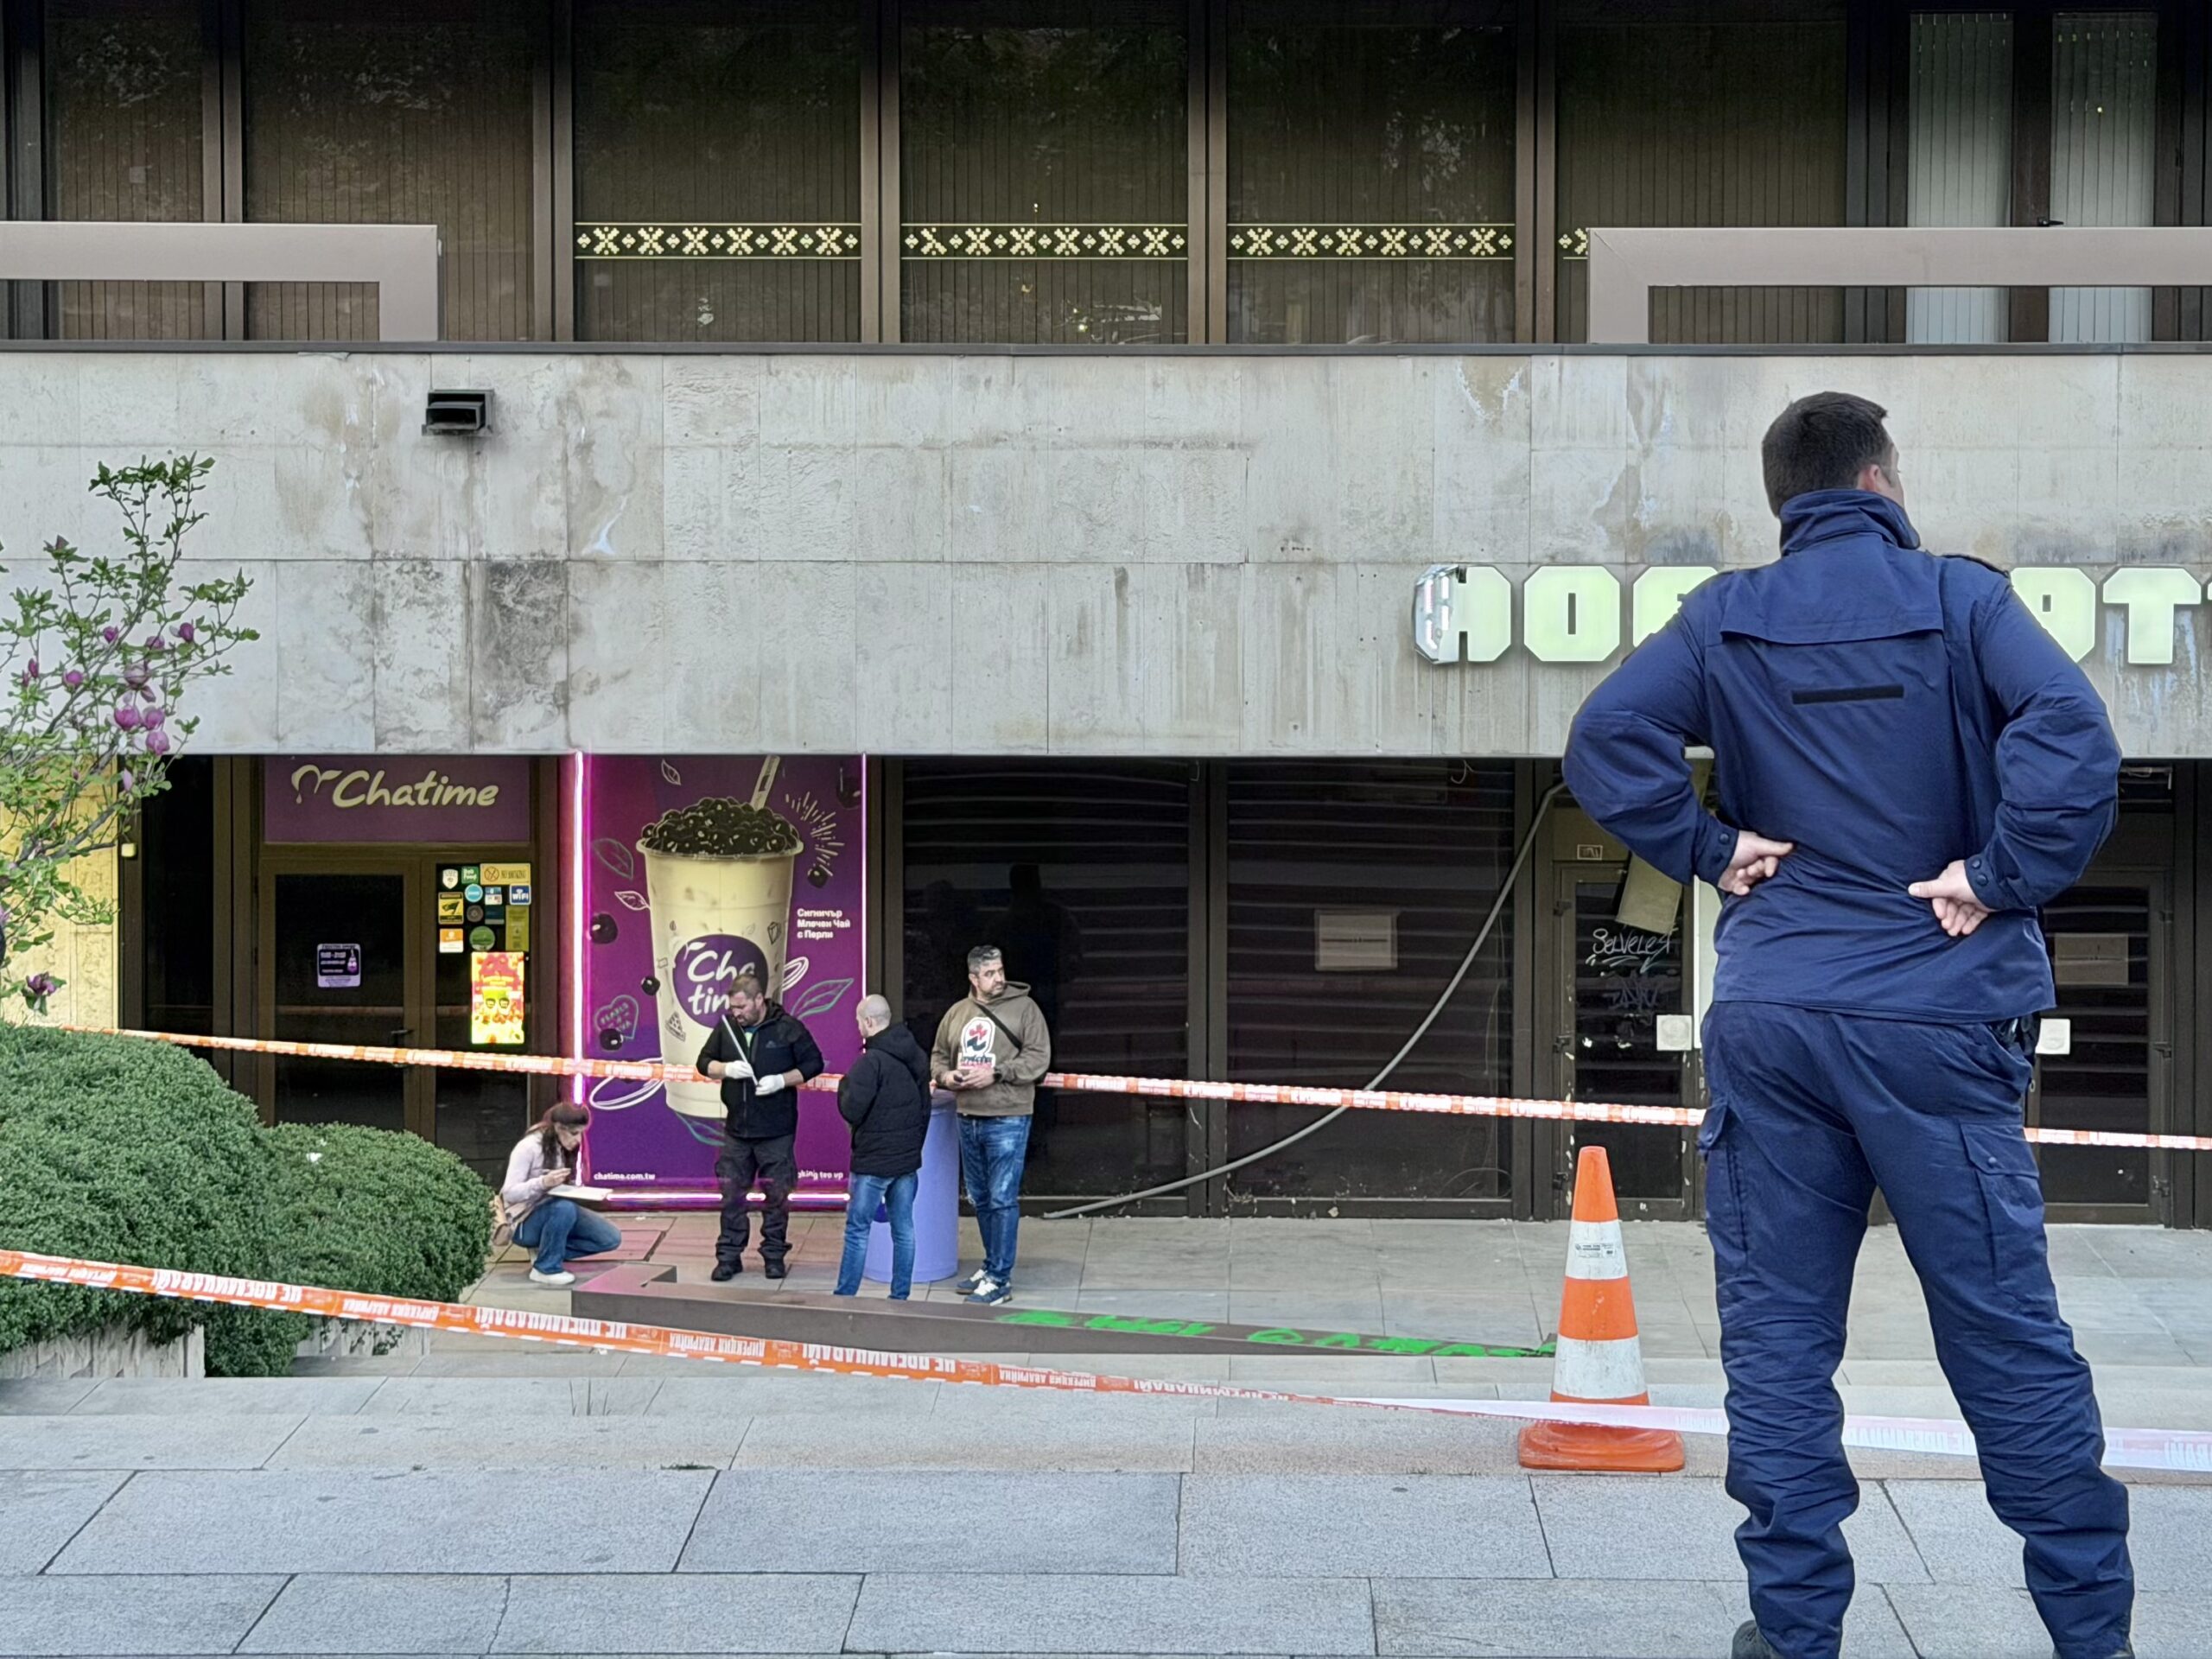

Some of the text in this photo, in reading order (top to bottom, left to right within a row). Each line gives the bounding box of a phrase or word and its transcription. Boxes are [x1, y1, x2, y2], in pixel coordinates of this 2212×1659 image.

[332, 770, 499, 808] Chatime
[797, 918, 851, 928] Млечен Чай
[804, 929, 834, 940] Перли
[593, 1172, 656, 1180] chatime.com.tw
